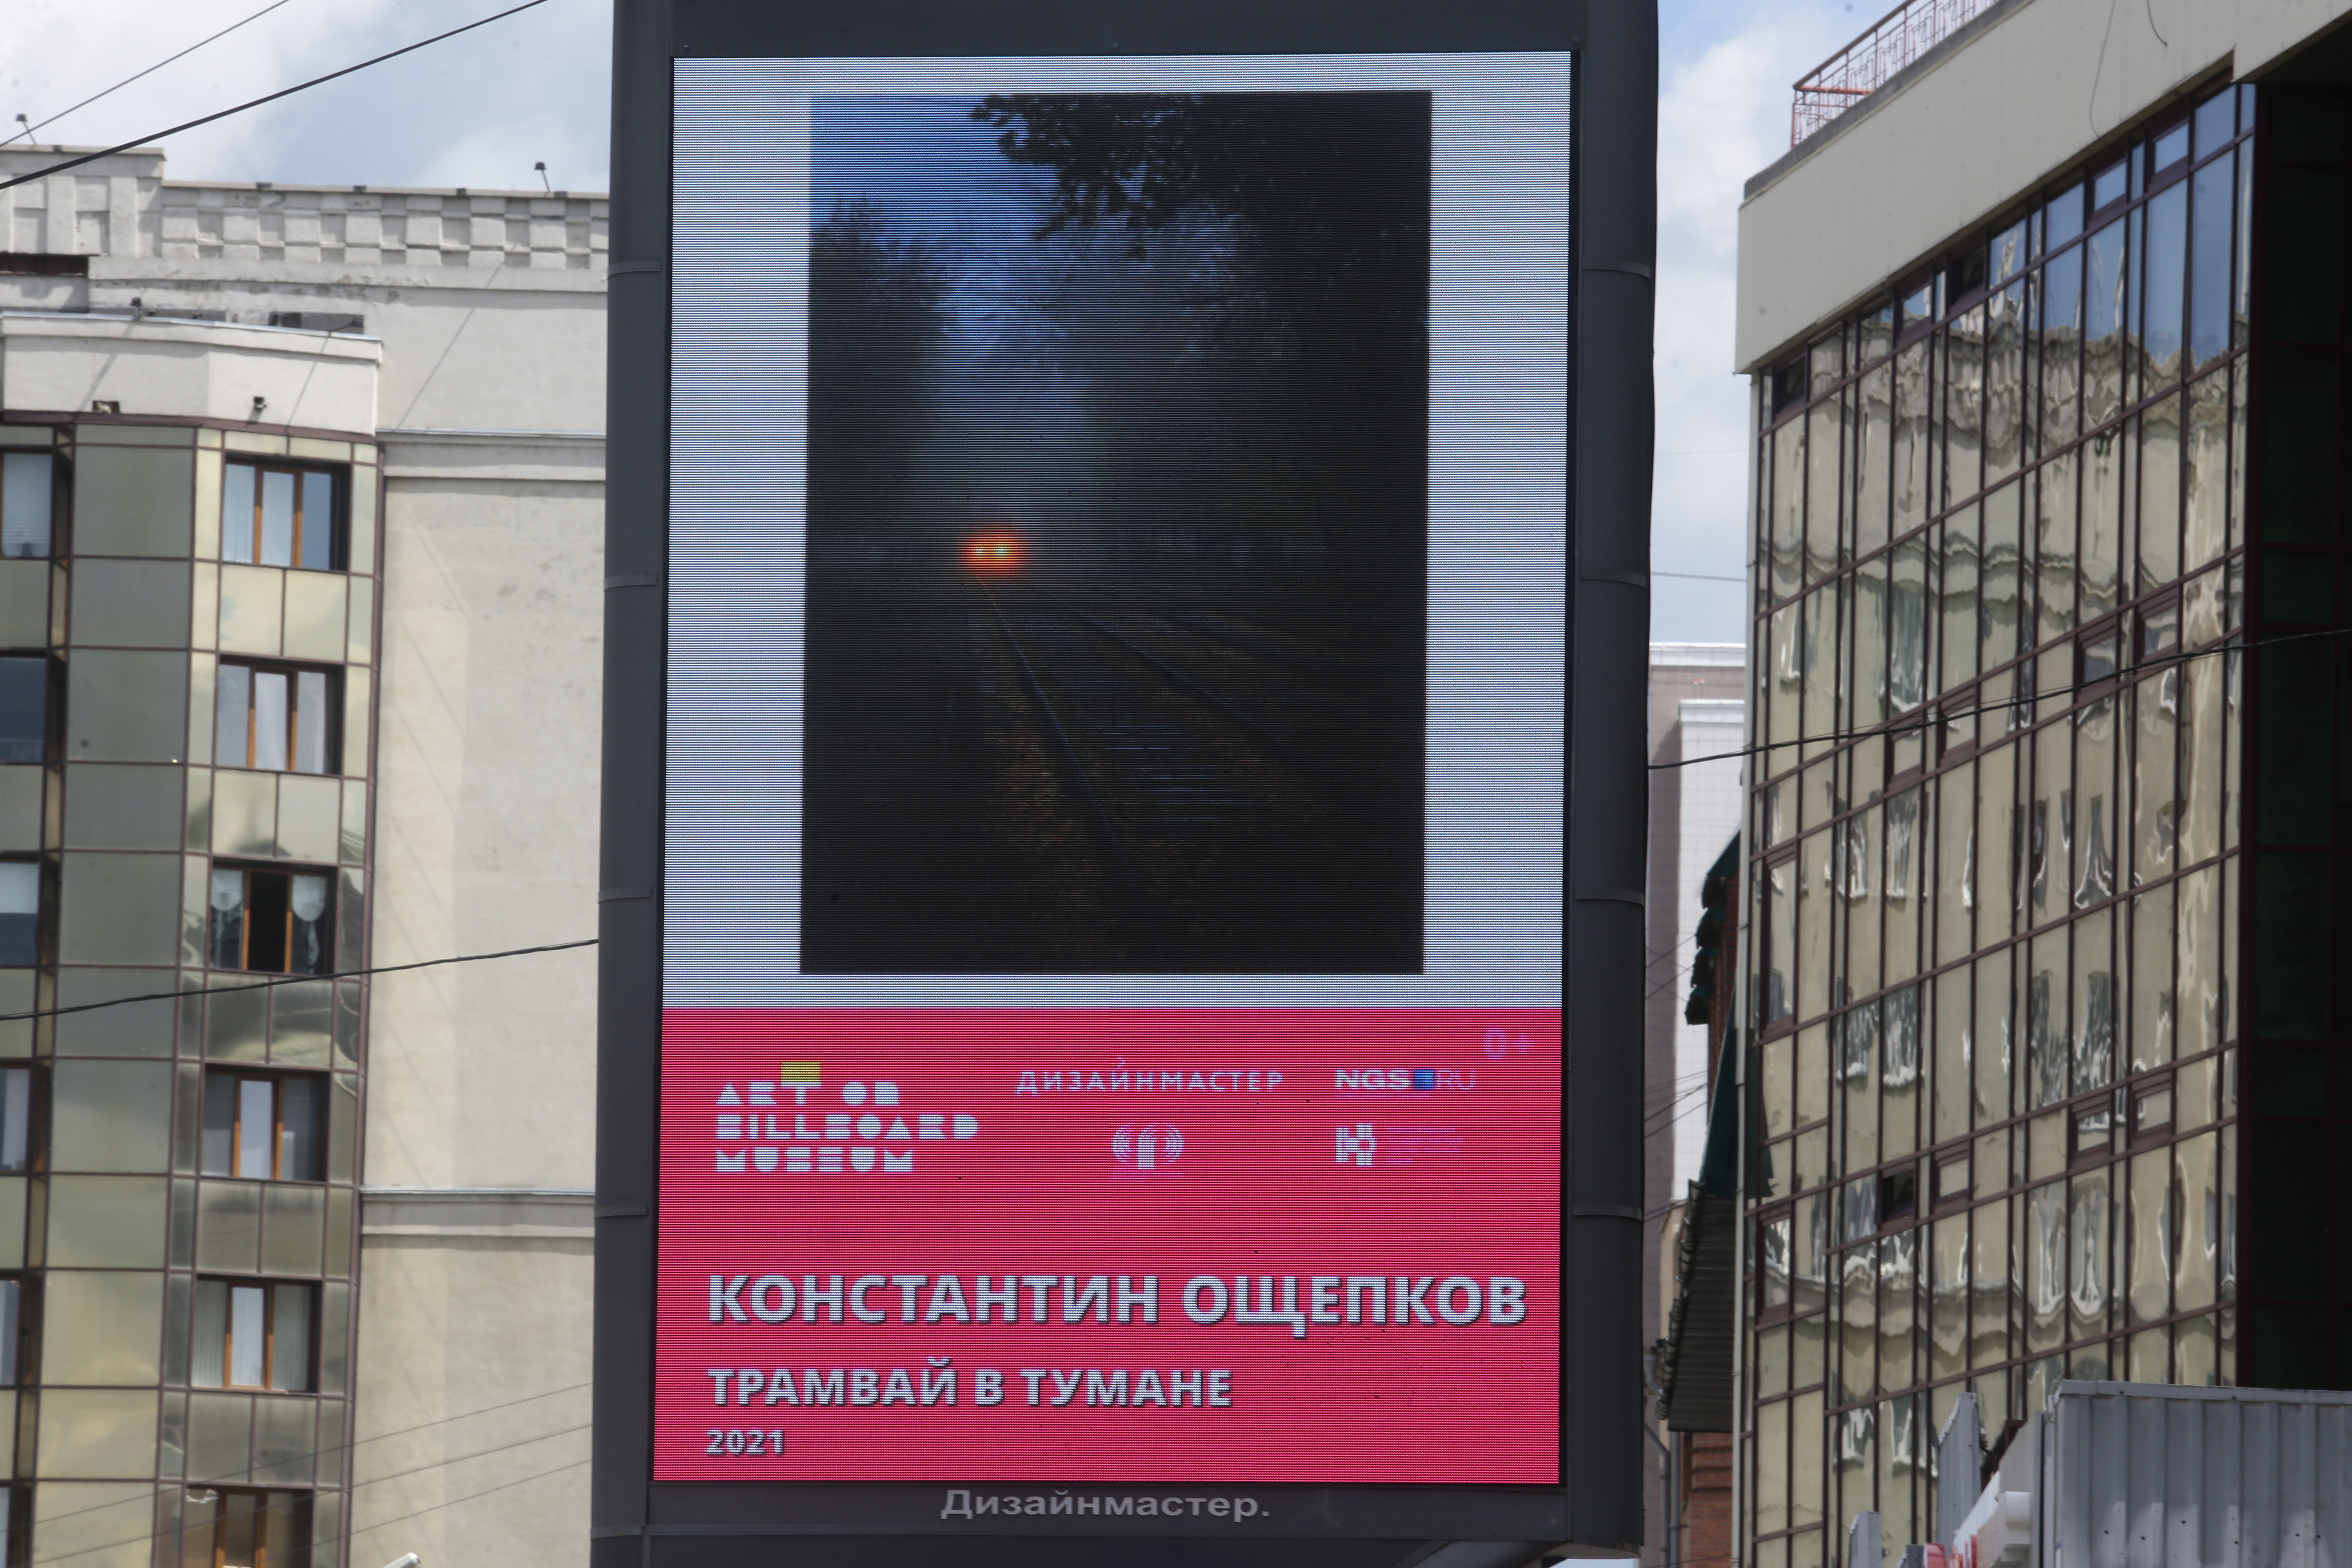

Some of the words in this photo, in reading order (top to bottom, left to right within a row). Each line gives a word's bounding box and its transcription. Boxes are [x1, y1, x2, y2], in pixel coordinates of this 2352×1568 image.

[1015, 1056, 1283, 1096] ДИЗАЙНМАСТЕР
[715, 1081, 821, 1105] ART
[715, 1114, 980, 1140] BILLBOARD
[715, 1147, 914, 1172] MUSEUM
[707, 1273, 1160, 1325] КОНСТАНТИН
[1182, 1276, 1529, 1339] ОЩЕПКОВ
[707, 1356, 958, 1407] ТРАМВАЙ
[977, 1369, 1005, 1407] В
[1021, 1368, 1234, 1409] ТУМАНЕ
[706, 1428, 786, 1456] 2021
[940, 1488, 1270, 1523] Дизайнмастер.
